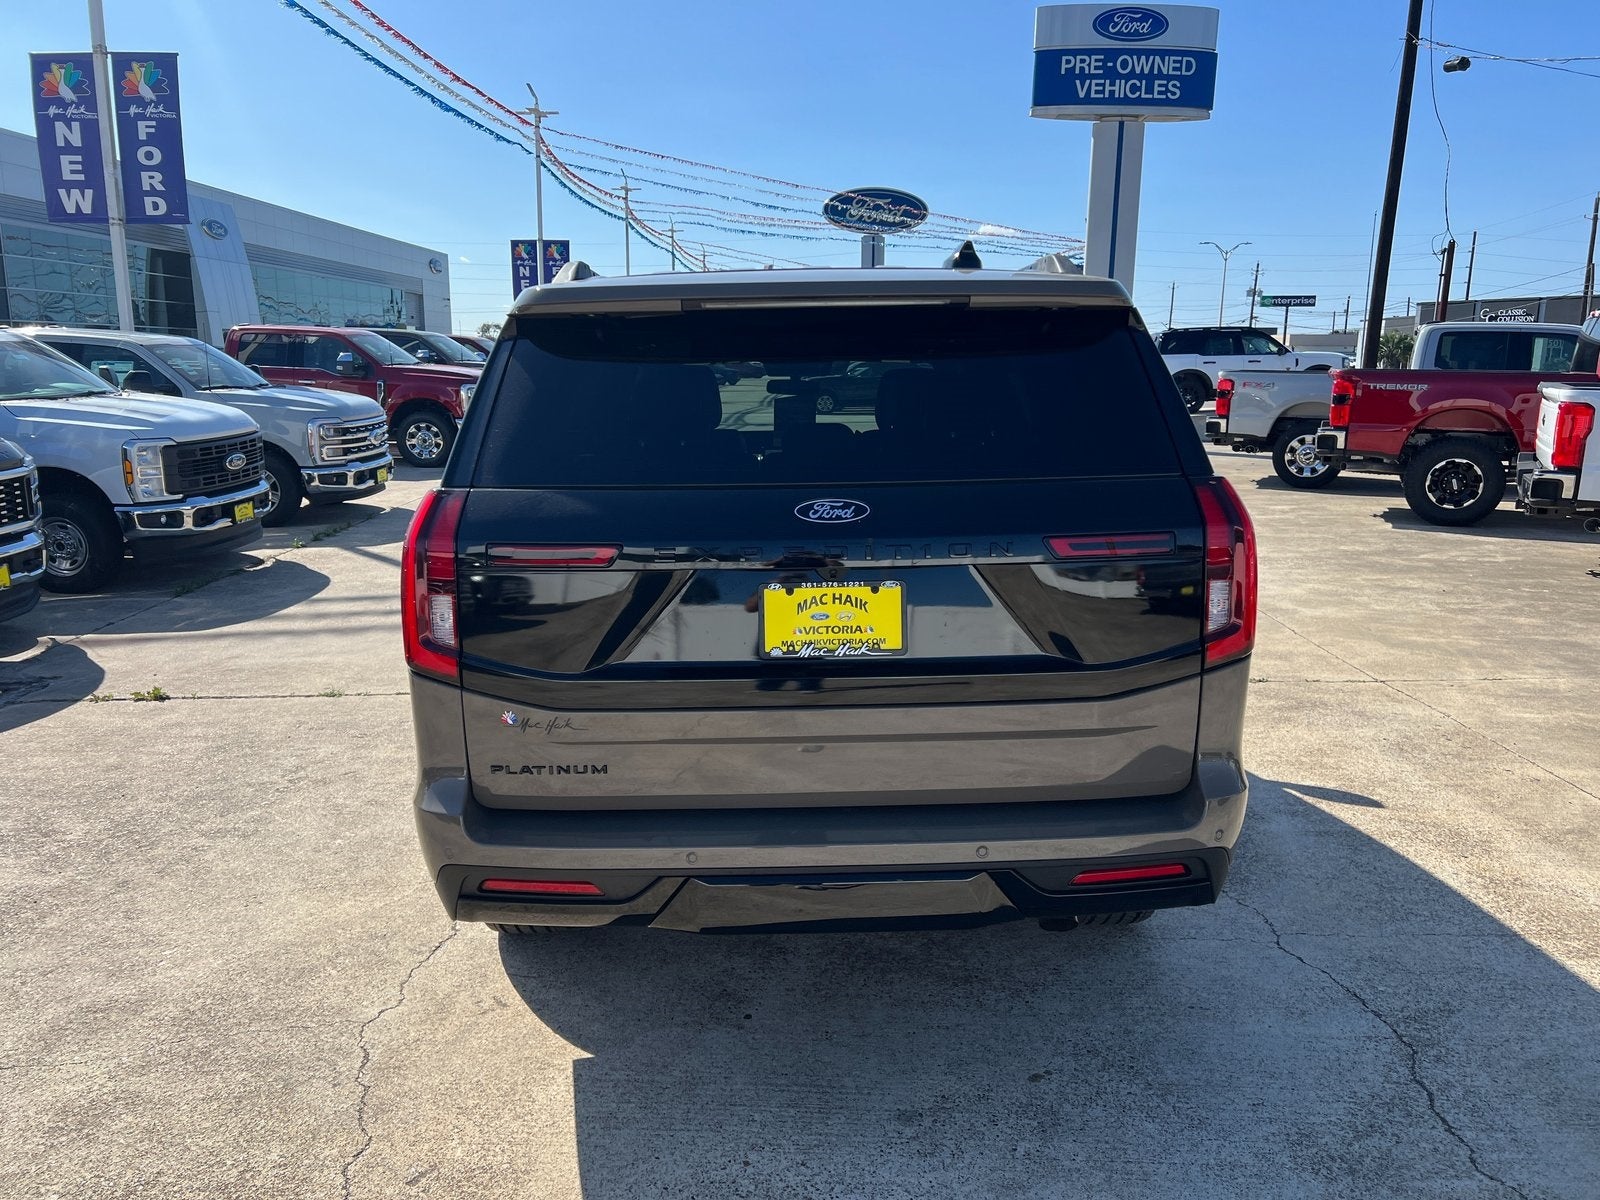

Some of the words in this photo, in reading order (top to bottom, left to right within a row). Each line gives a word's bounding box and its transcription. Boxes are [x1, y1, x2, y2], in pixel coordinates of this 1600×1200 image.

[1109, 12, 1152, 34] Ford
[1060, 55, 1197, 76] PRE-OWNED
[1075, 79, 1181, 100] VEHICLES
[48, 104, 65, 119] Mac
[65, 103, 87, 119] Haik
[128, 104, 145, 118] Mac
[145, 102, 167, 118] Haik
[54, 121, 93, 214] NEW
[136, 120, 168, 216] FORD
[845, 196, 905, 223] Ford
[519, 266, 530, 291] NE
[1264, 296, 1315, 306] enterprise
[1497, 315, 1535, 323] COLLISION
[1242, 381, 1275, 390] FX4
[1367, 383, 1429, 391] TREMOR
[808, 501, 856, 518] Ford
[653, 542, 1014, 563] EXPEDITION
[801, 581, 865, 589] 361-576-1221
[796, 593, 829, 615] MAC
[832, 593, 869, 613] HAIK
[802, 625, 864, 636] VICTORIA
[781, 637, 887, 648] MACHAIKVICTORIA.COM
[797, 642, 830, 658] Mac
[833, 642, 873, 657] Haik
[519, 717, 542, 734] Mac
[544, 716, 574, 735] Haik
[490, 764, 608, 775] PLATINUM
